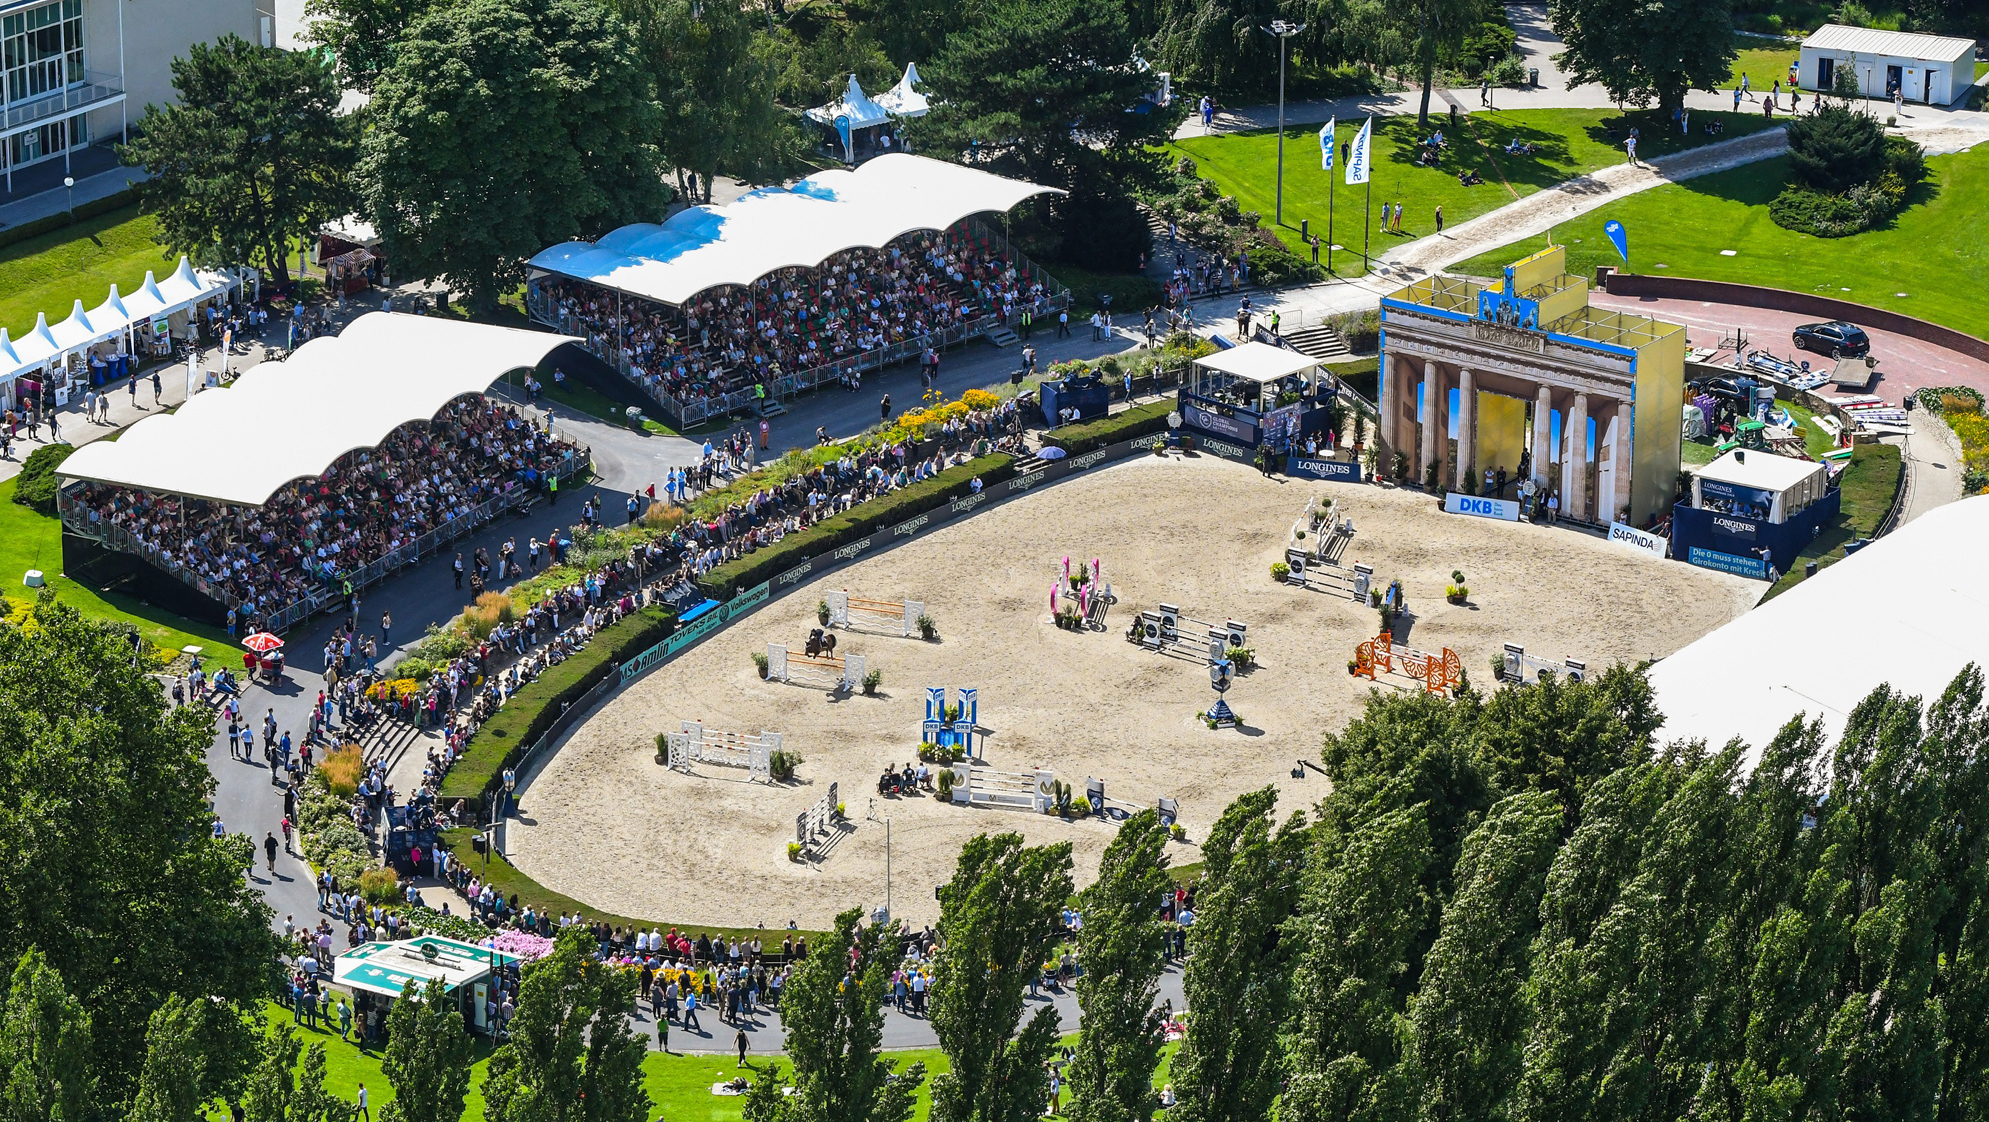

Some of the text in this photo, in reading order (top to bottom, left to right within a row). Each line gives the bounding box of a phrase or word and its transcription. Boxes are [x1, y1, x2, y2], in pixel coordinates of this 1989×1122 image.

[1203, 438, 1244, 457] LONGINES
[1069, 450, 1106, 469] LONGINES
[1297, 460, 1350, 474] LONGINES
[1008, 470, 1045, 490] LONGINES
[1704, 482, 1733, 493] LONGINES
[951, 492, 986, 512] LONGINES
[1460, 498, 1492, 514] DKB
[893, 515, 929, 536] LONGINES
[1713, 517, 1755, 532] LONGINES
[834, 538, 871, 560] LONGINES
[1612, 528, 1654, 550] SAPINDA
[1692, 557, 1729, 570] Girokonto
[1730, 565, 1743, 574] mit
[1693, 548, 1706, 558] Die
[1713, 553, 1731, 563] muss
[1732, 557, 1759, 568] stehen.
[779, 562, 812, 585] LONGINES
[731, 586, 769, 612] Volkswagen
[670, 611, 719, 645] TOVEKS BIL
[621, 641, 669, 681] MS amlin
